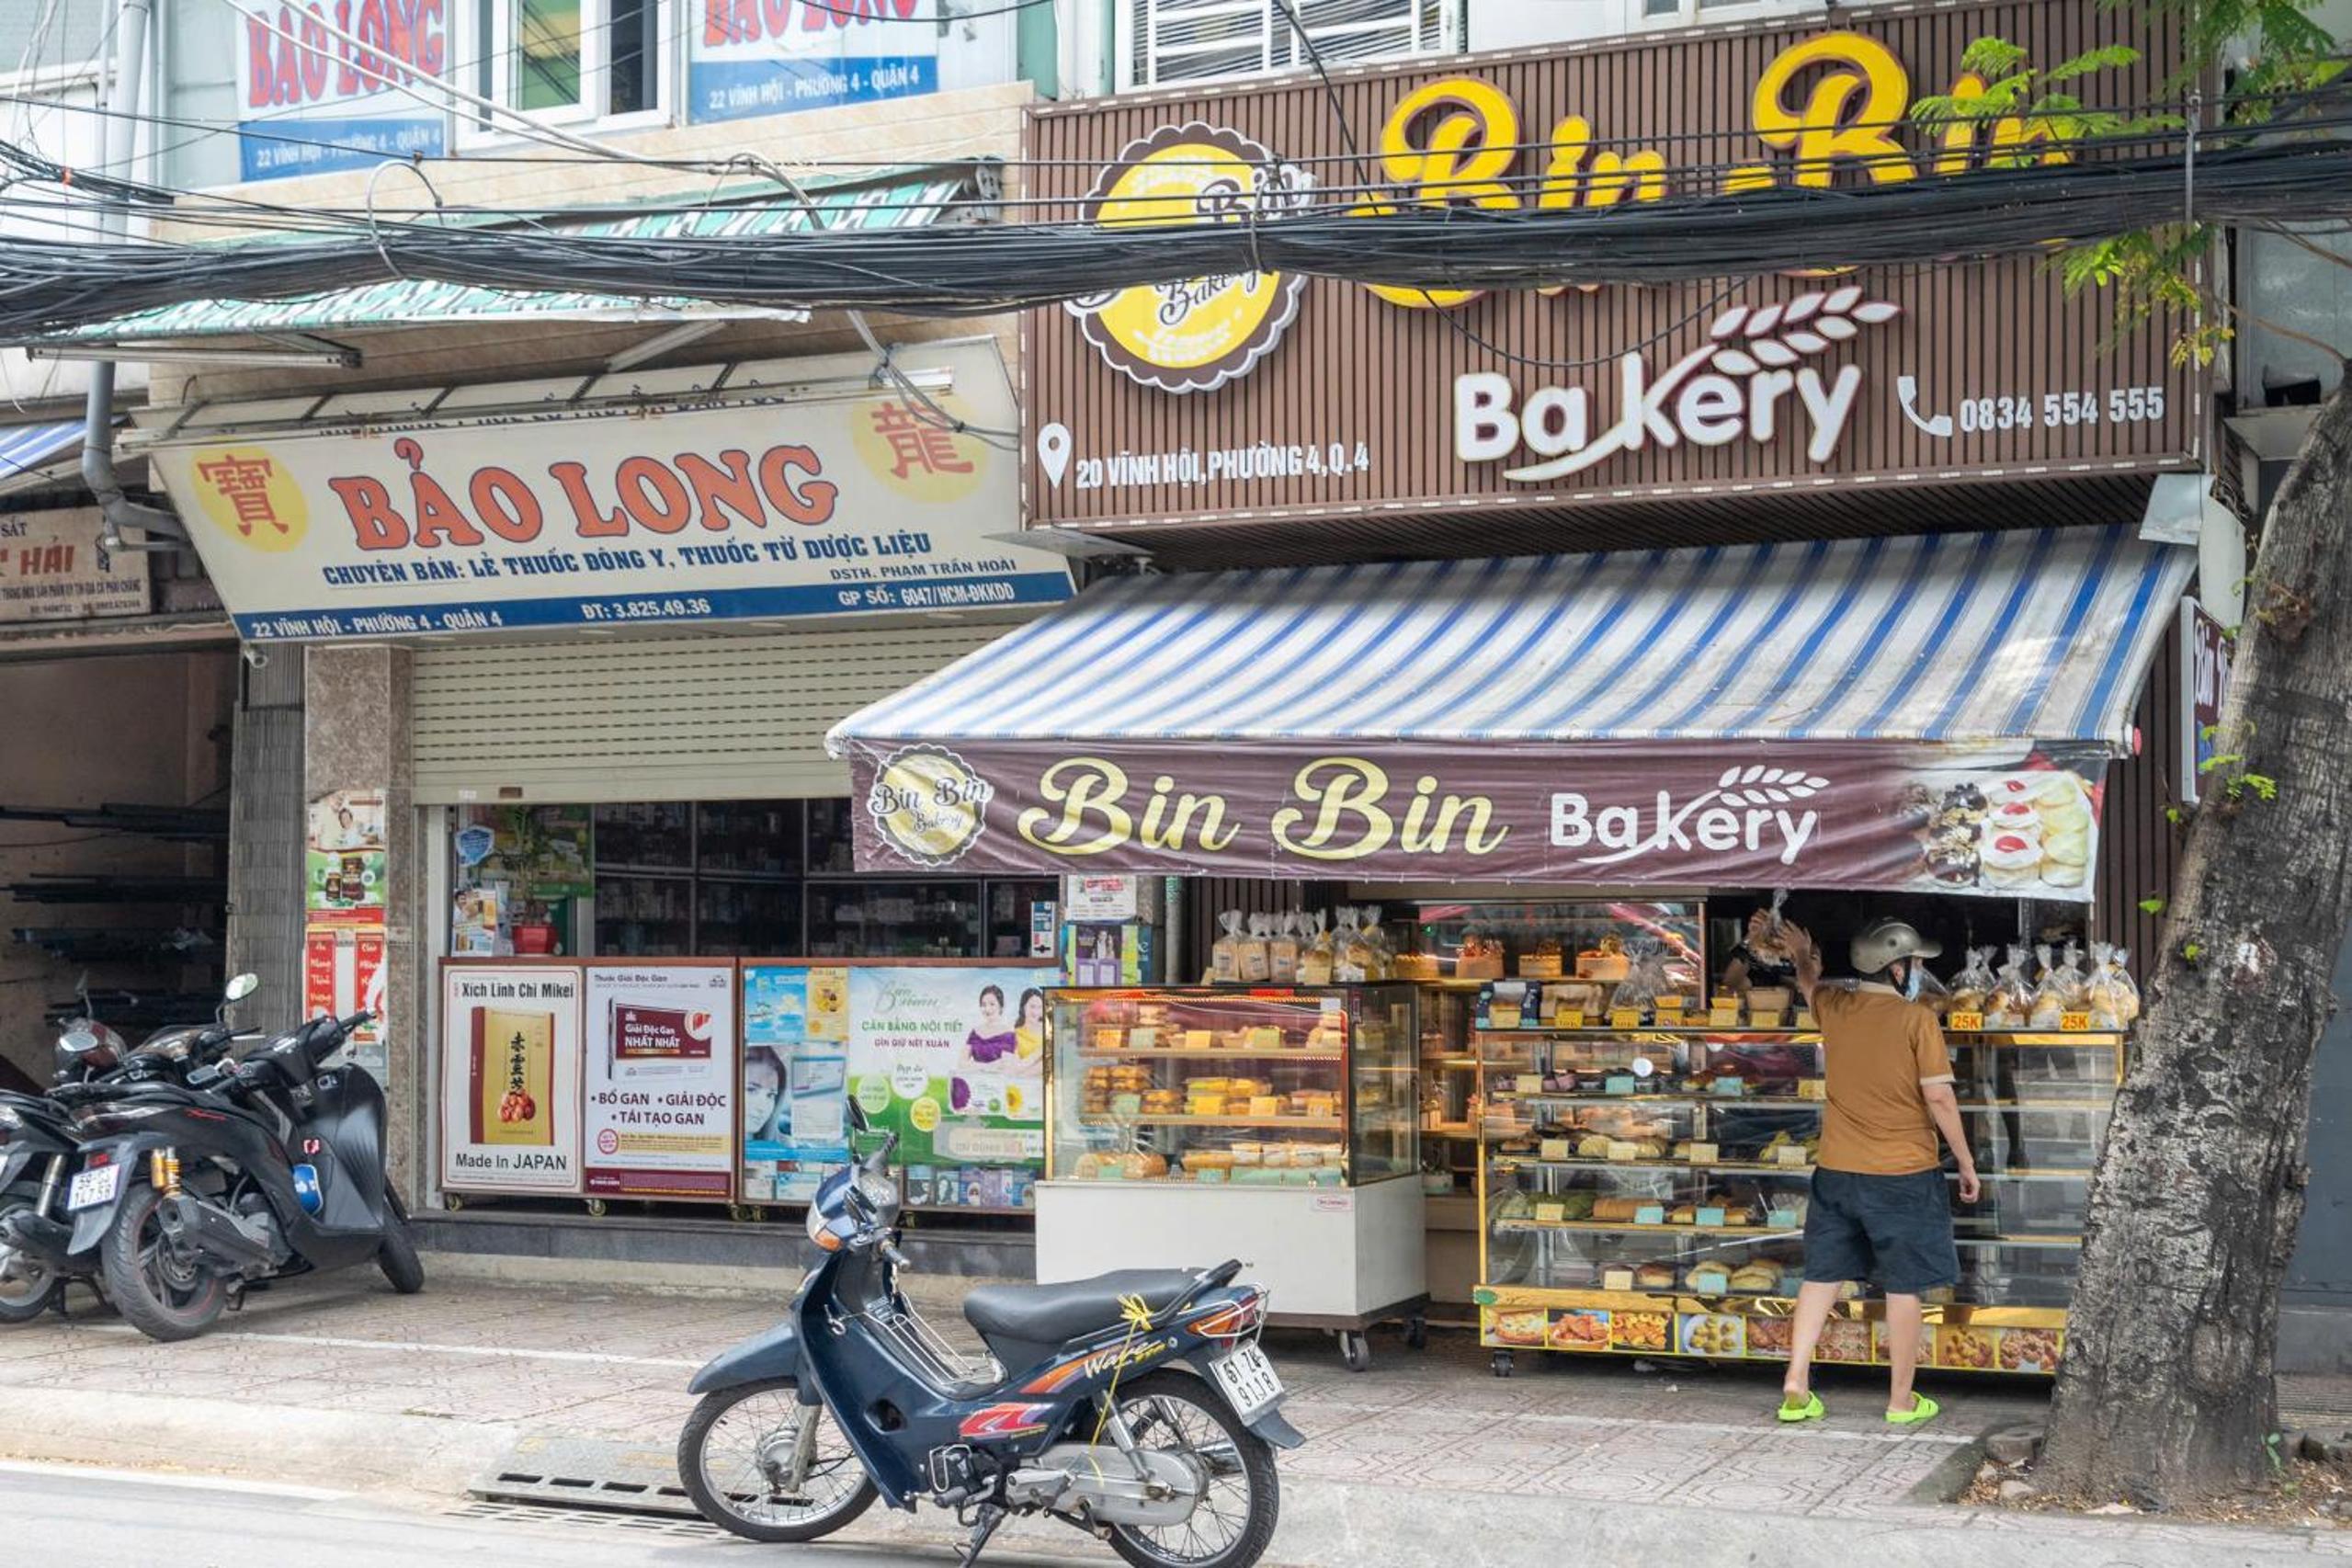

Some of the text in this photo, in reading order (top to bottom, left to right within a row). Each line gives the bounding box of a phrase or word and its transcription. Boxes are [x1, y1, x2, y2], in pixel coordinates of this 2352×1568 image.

[709, 90, 726, 109] 22
[849, 74, 861, 92] 4
[909, 65, 920, 85] 4
[1455, 342, 1862, 483] Bakery
[1960, 386, 2165, 433] 0834 554 555
[870, 401, 976, 481] 龍
[1075, 458, 1104, 489] 20
[1106, 449, 1159, 486] VĨNH
[197, 453, 290, 538] 寶
[327, 437, 839, 551] BẢO LONG
[323, 559, 408, 586] CHUYÊN
[502, 546, 580, 576] THUỐC
[583, 545, 646, 574] ĐÔNG
[649, 548, 676, 569] Y,
[677, 537, 757, 567] THUỐC
[872, 528, 932, 555] LIỆU
[615, 597, 712, 619] 3.825.49.36
[838, 589, 862, 607] GP
[251, 623, 273, 638] 22
[272, 616, 312, 638] VĨNH
[312, 615, 342, 638] HỘI
[353, 612, 417, 634] PHƯỜNG
[418, 614, 429, 630] 4
[442, 607, 490, 630] QUẬN
[490, 610, 503, 627] 4
[870, 777, 985, 815] Bin Bin
[1017, 756, 1819, 866] Bin Bin Bakery
[491, 982, 516, 999] Linh
[518, 983, 538, 999] Chi
[541, 983, 574, 999] Mikei
[660, 1026, 676, 1035] Gan
[1953, 1016, 1981, 1030] 25K
[2062, 1015, 2089, 1029] 25K
[620, 1093, 650, 1106] GAN
[665, 1091, 694, 1107] GIẢI
[696, 1093, 727, 1110] ĐỘC
[619, 1109, 705, 1128] TÁI TẠO GAN
[456, 1153, 492, 1168] Made
[513, 1153, 567, 1171] JAPAN
